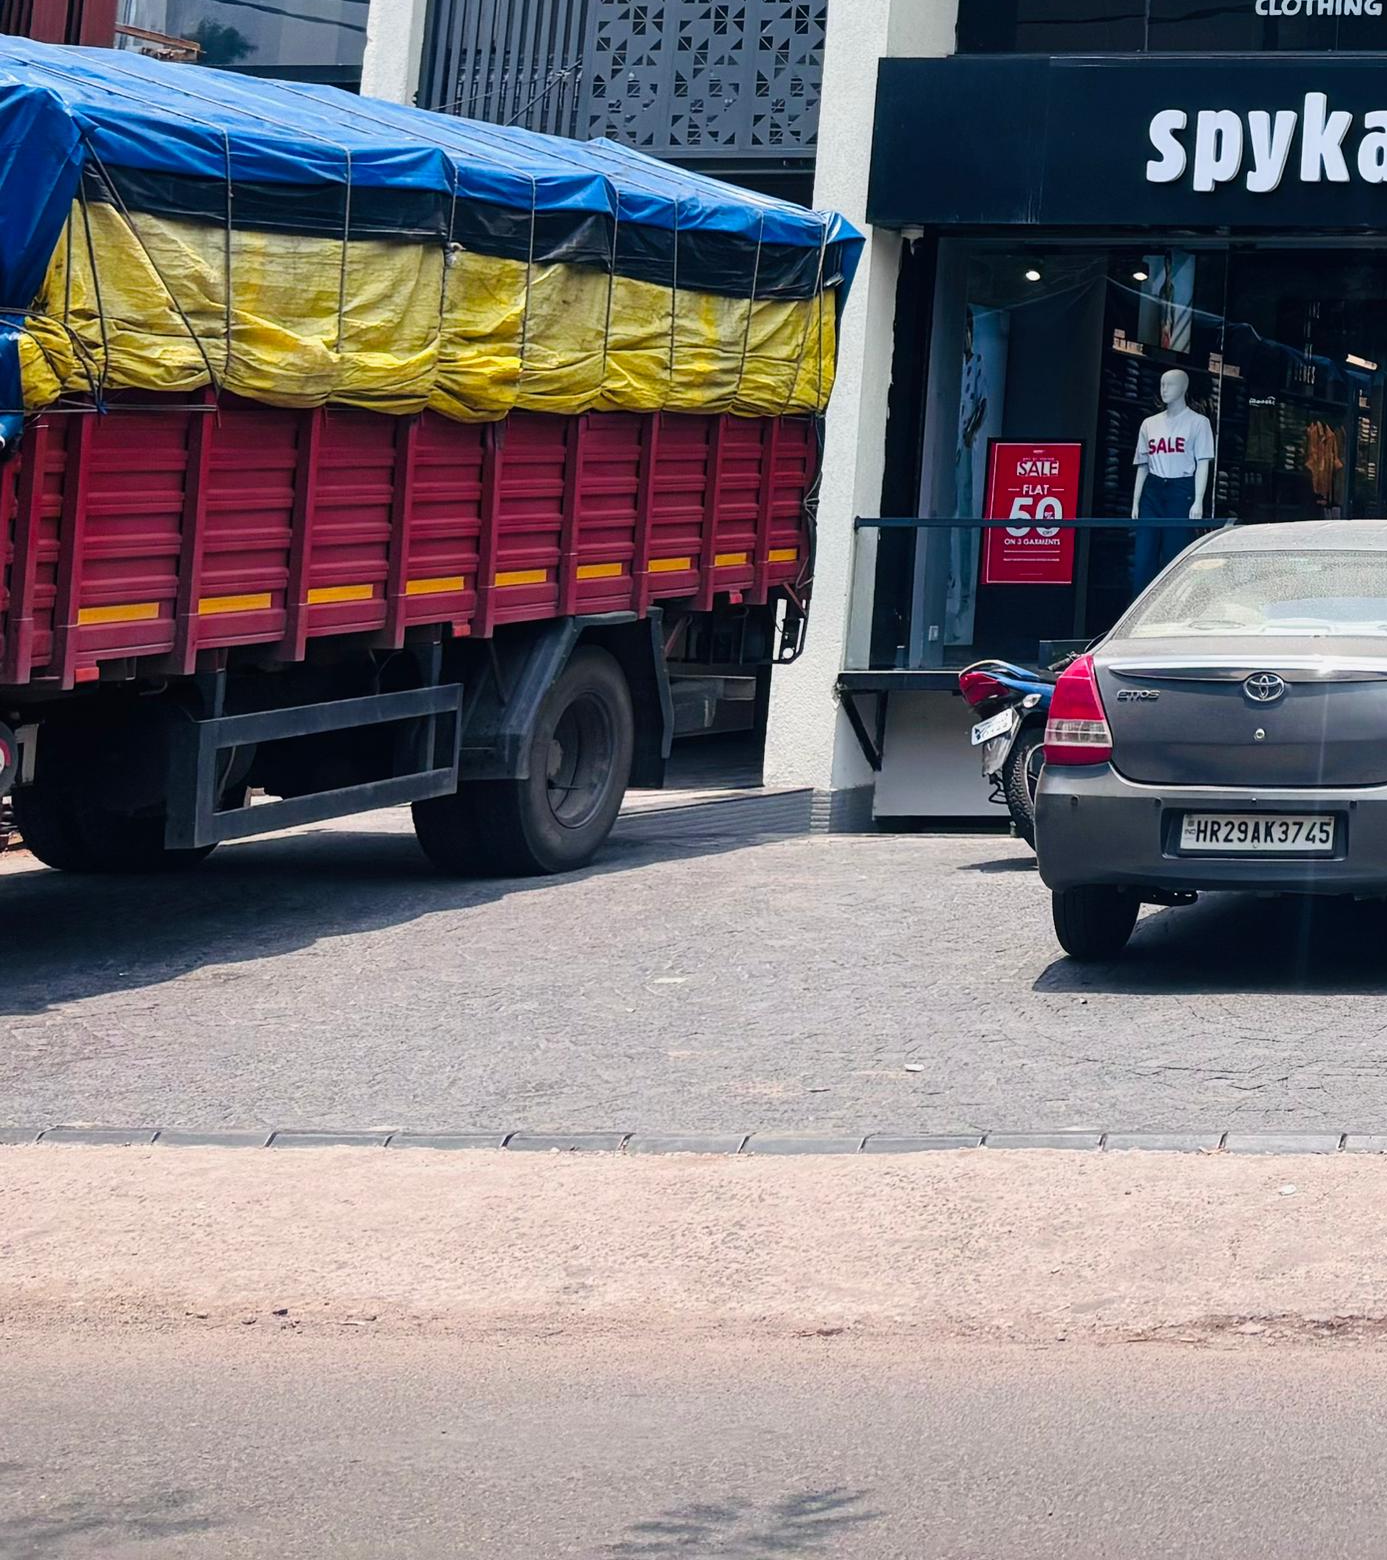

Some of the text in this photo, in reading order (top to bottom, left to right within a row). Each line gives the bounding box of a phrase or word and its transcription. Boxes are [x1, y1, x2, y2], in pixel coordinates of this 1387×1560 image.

[1147, 436, 1187, 455] SALE
[1017, 460, 1060, 477] SALE
[1022, 484, 1050, 495] FLAT
[1005, 496, 1063, 537] 50
[1195, 820, 1332, 843] HR29AK3745
